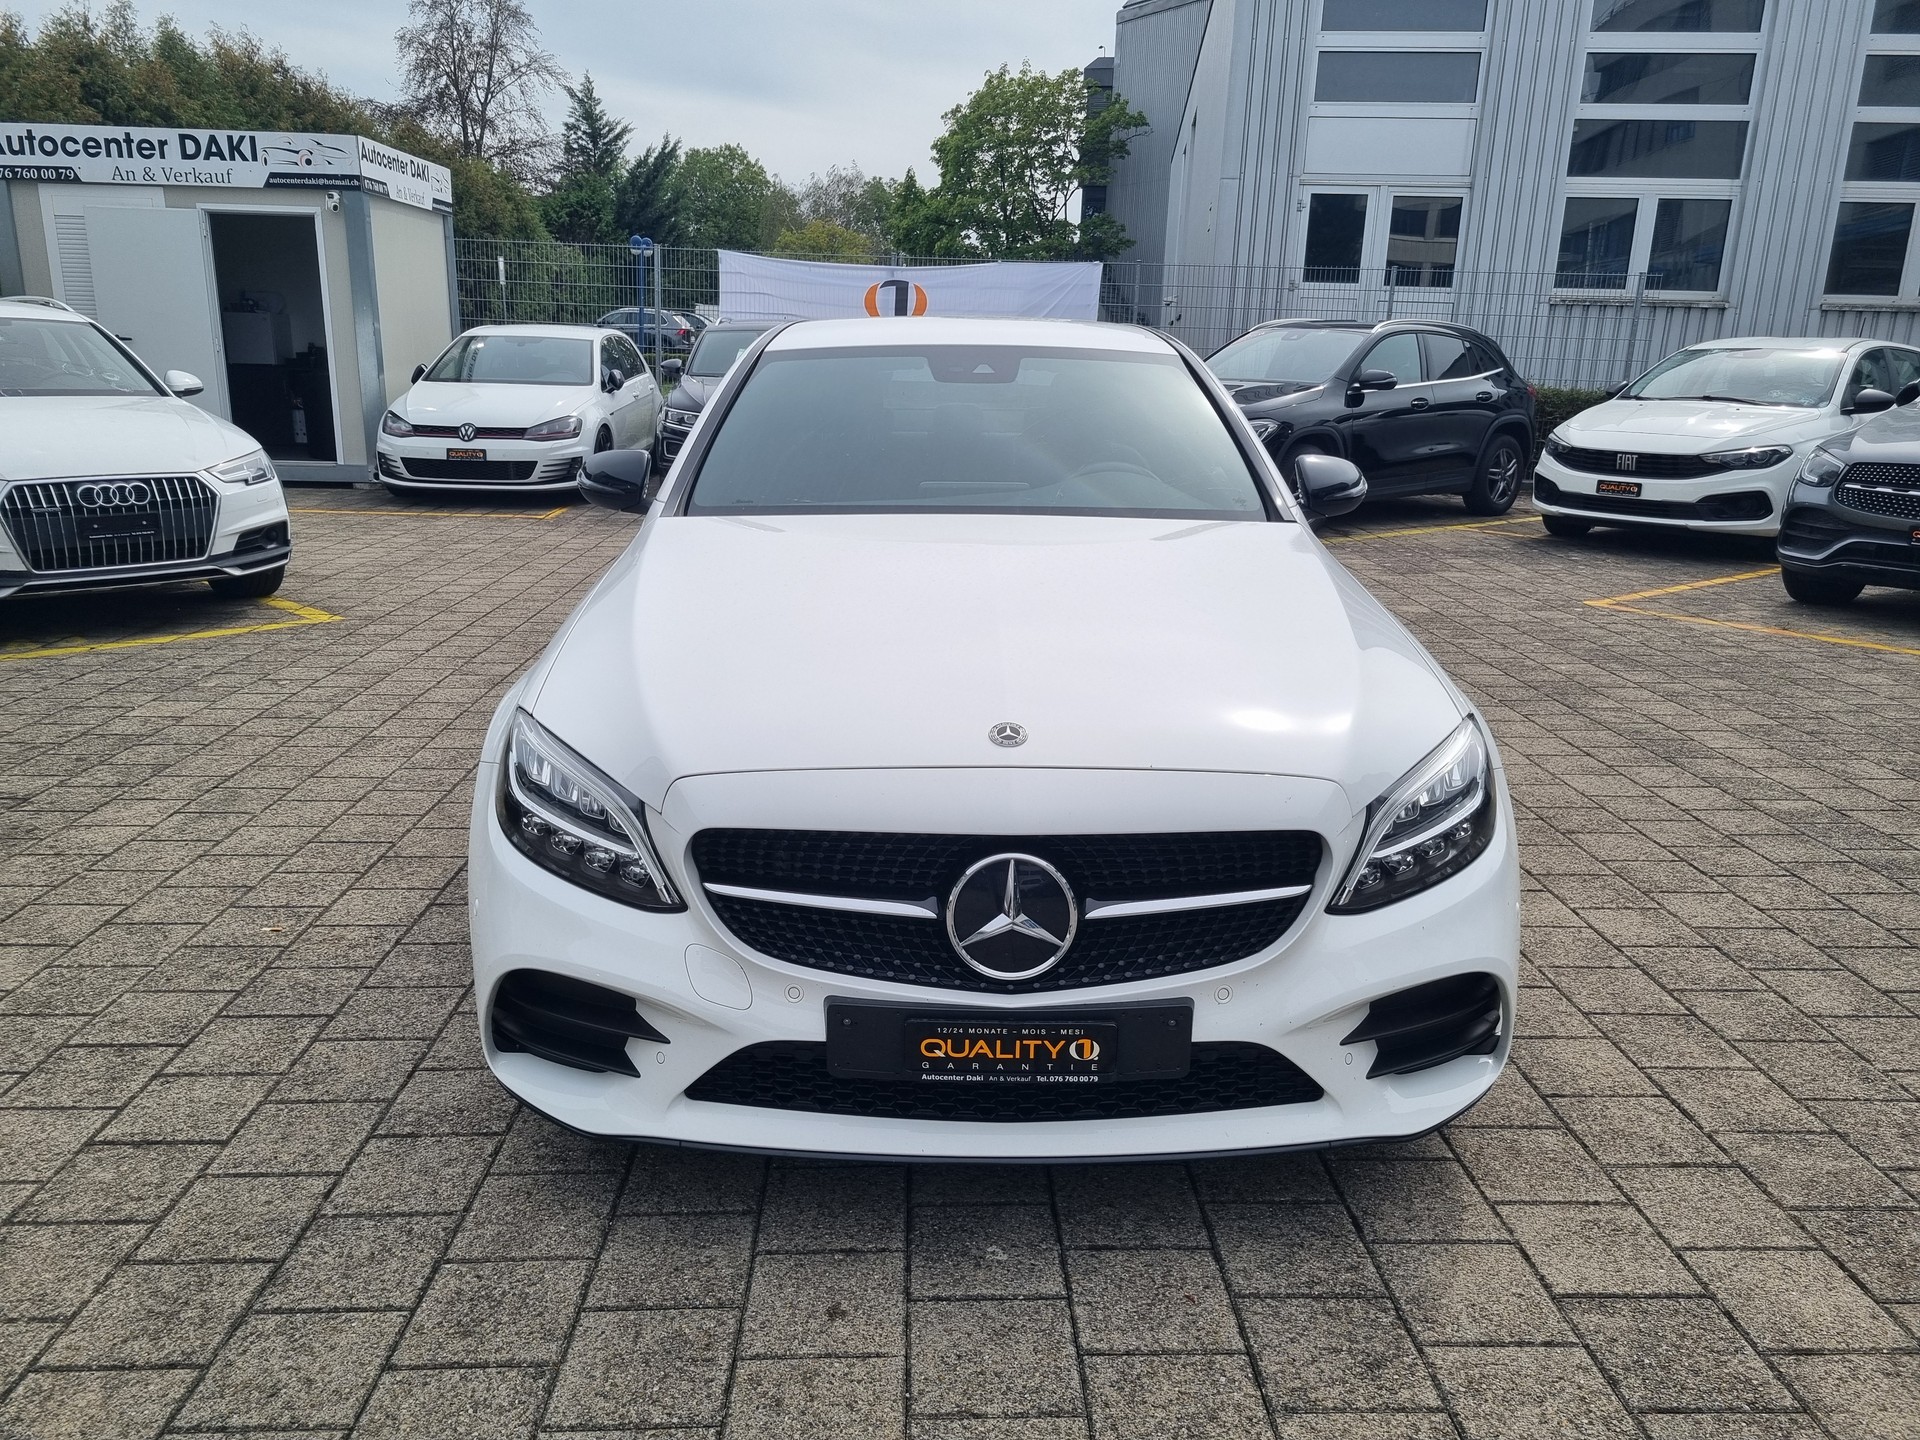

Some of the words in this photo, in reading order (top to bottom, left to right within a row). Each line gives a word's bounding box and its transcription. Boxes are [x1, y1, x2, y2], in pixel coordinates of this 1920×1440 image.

[0, 129, 168, 160] utocenter
[178, 133, 258, 162] DAKI
[361, 142, 409, 176] Autocenter
[410, 159, 430, 183] DAKI
[15, 168, 37, 179] 760
[41, 168, 56, 180] 00
[59, 169, 74, 180] 79
[112, 166, 136, 181] An
[142, 166, 157, 182] &
[160, 167, 233, 184] Verkauf
[1616, 453, 1639, 471] FIAT
[968, 1027, 1008, 1035] MONATE
[1060, 1028, 1084, 1036] MESI
[920, 1038, 1066, 1059] QUALITY
[921, 1061, 1098, 1071] GARANTIE
[921, 1073, 964, 1081] Autocenter
